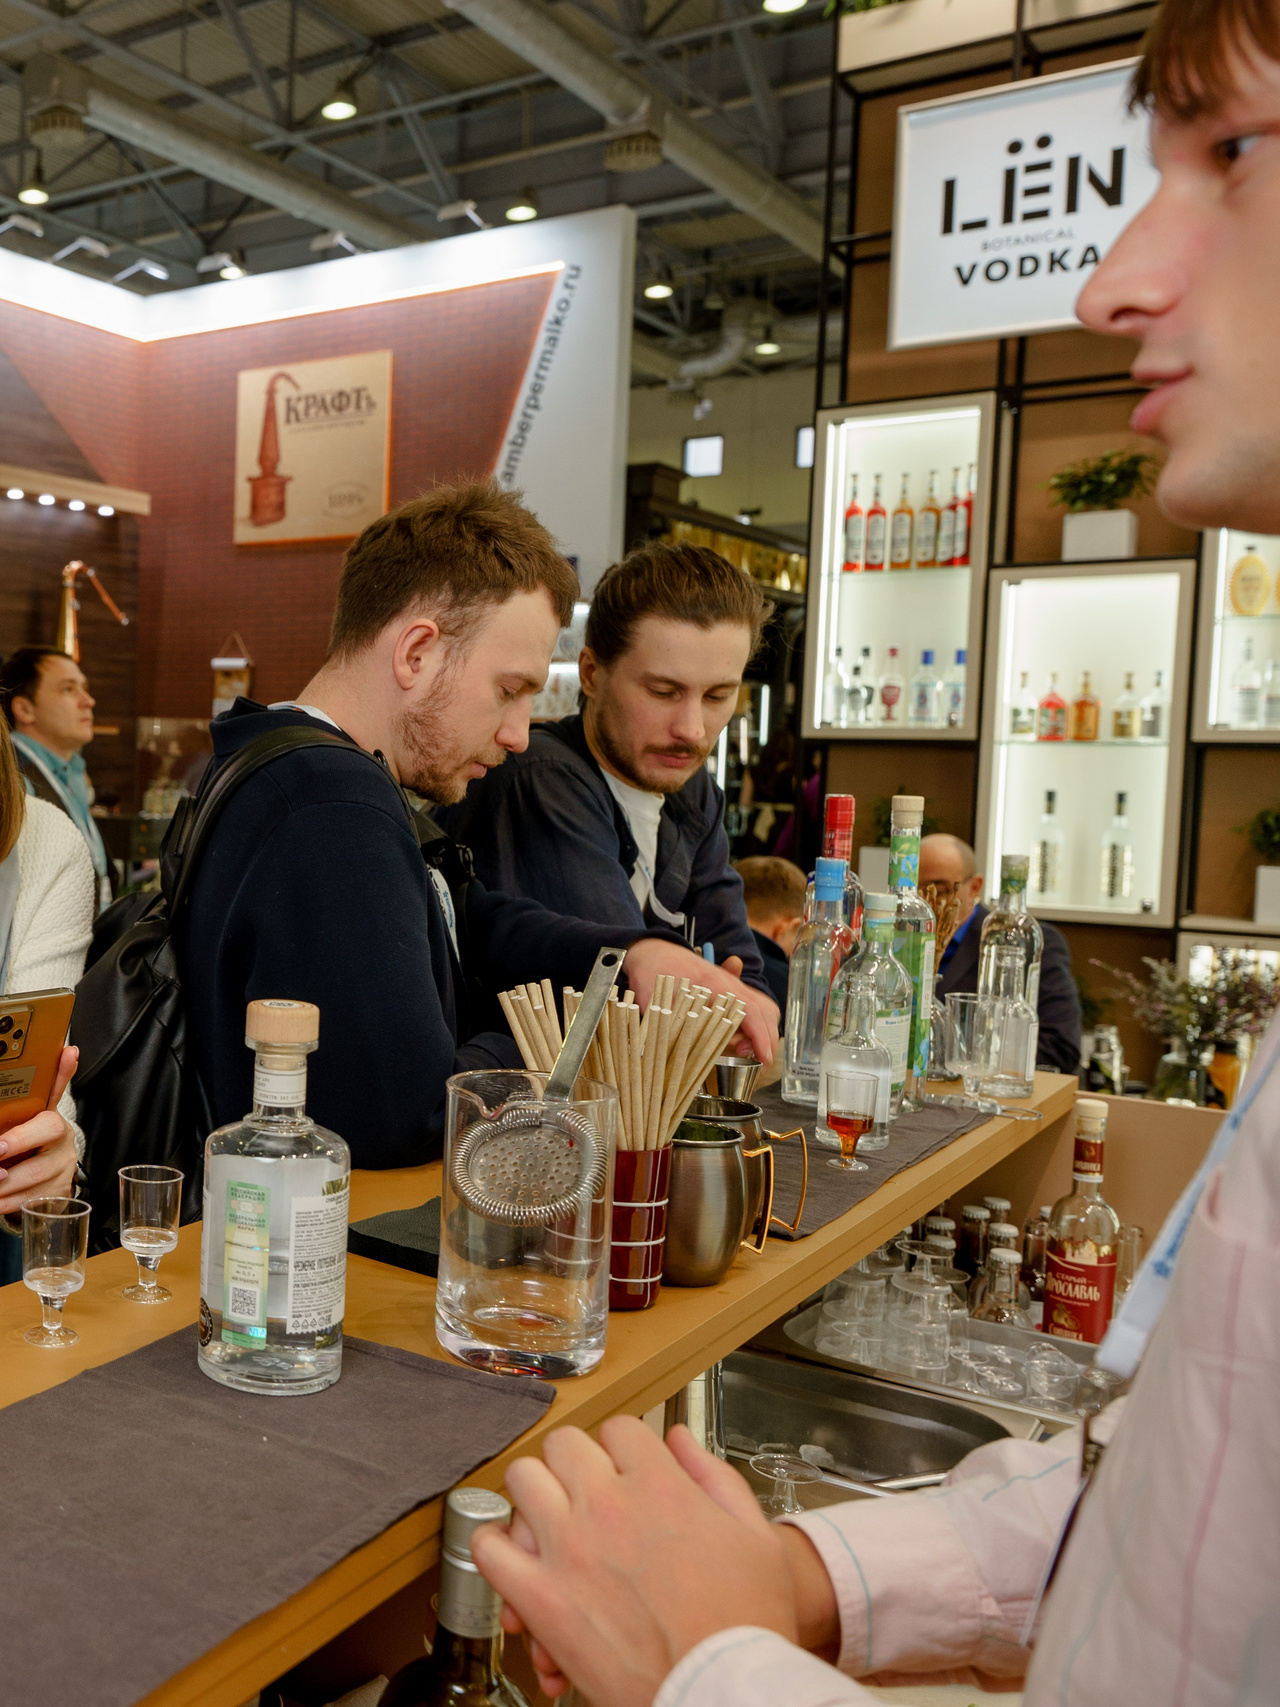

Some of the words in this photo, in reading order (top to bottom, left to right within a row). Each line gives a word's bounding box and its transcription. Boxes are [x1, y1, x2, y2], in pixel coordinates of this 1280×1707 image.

[941, 134, 1126, 235] LËN
[981, 228, 1076, 251] BOTANICAL
[955, 244, 1102, 287] VODKA
[1046, 1271, 1101, 1302] ЯРОСЛАВЛЬ
